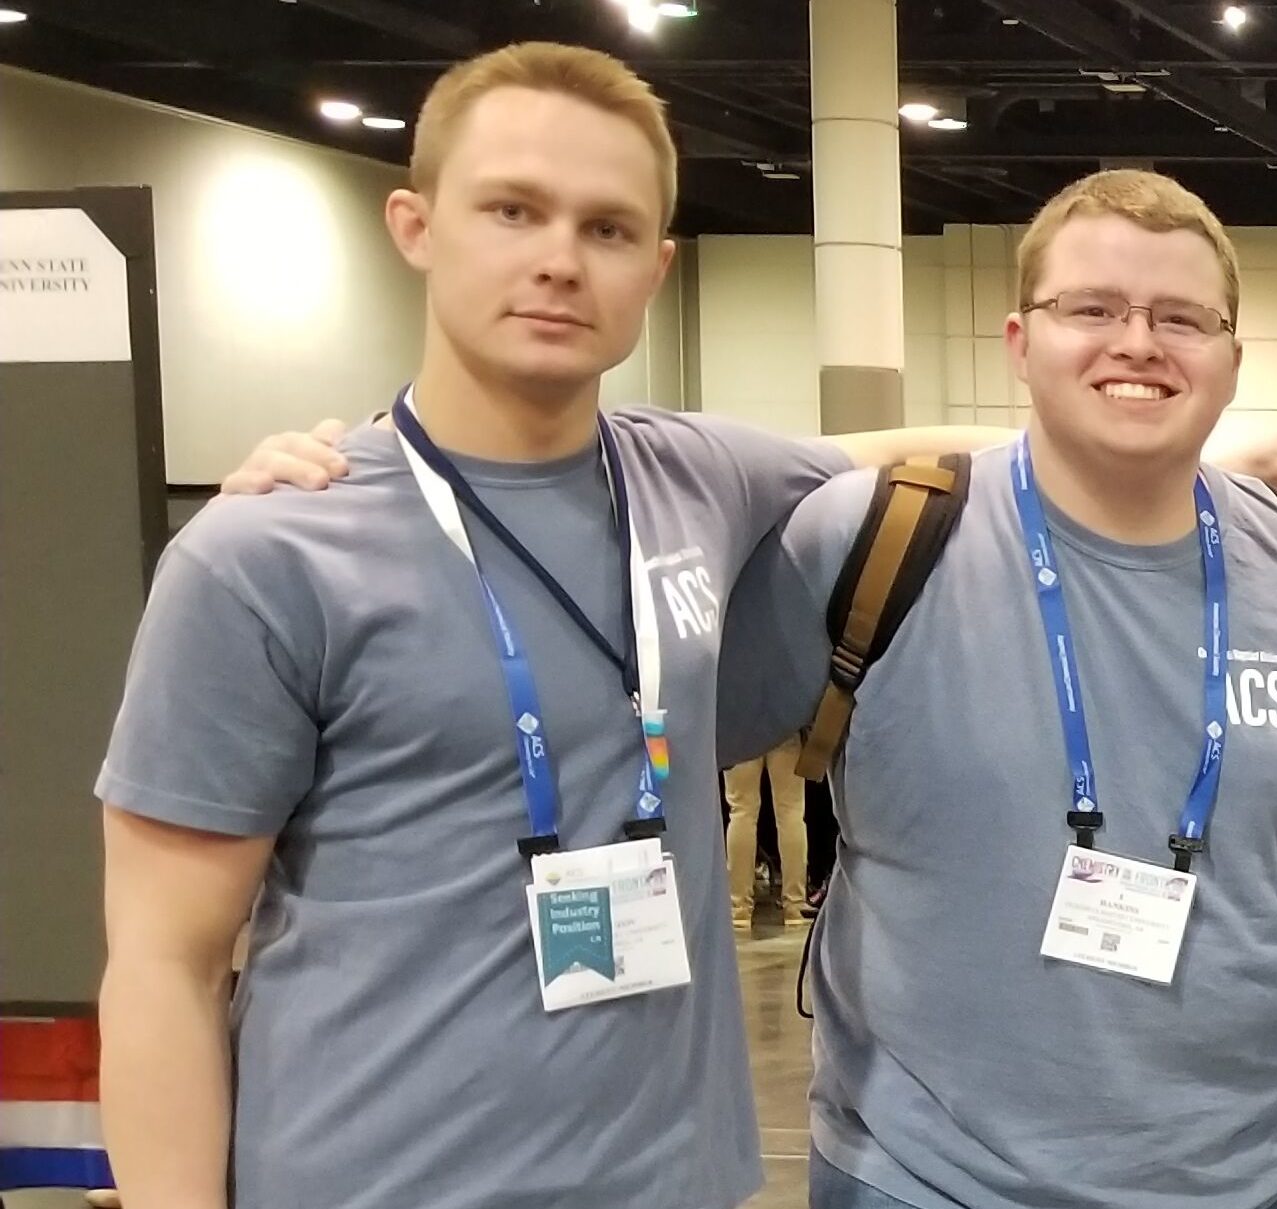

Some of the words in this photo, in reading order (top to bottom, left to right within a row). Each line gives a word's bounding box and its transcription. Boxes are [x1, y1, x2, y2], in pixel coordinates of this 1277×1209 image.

[37, 257, 90, 272] STATE
[661, 566, 719, 639] ACS
[550, 891, 599, 905] Seeking
[550, 905, 600, 919] Industry
[552, 920, 601, 934] Position
